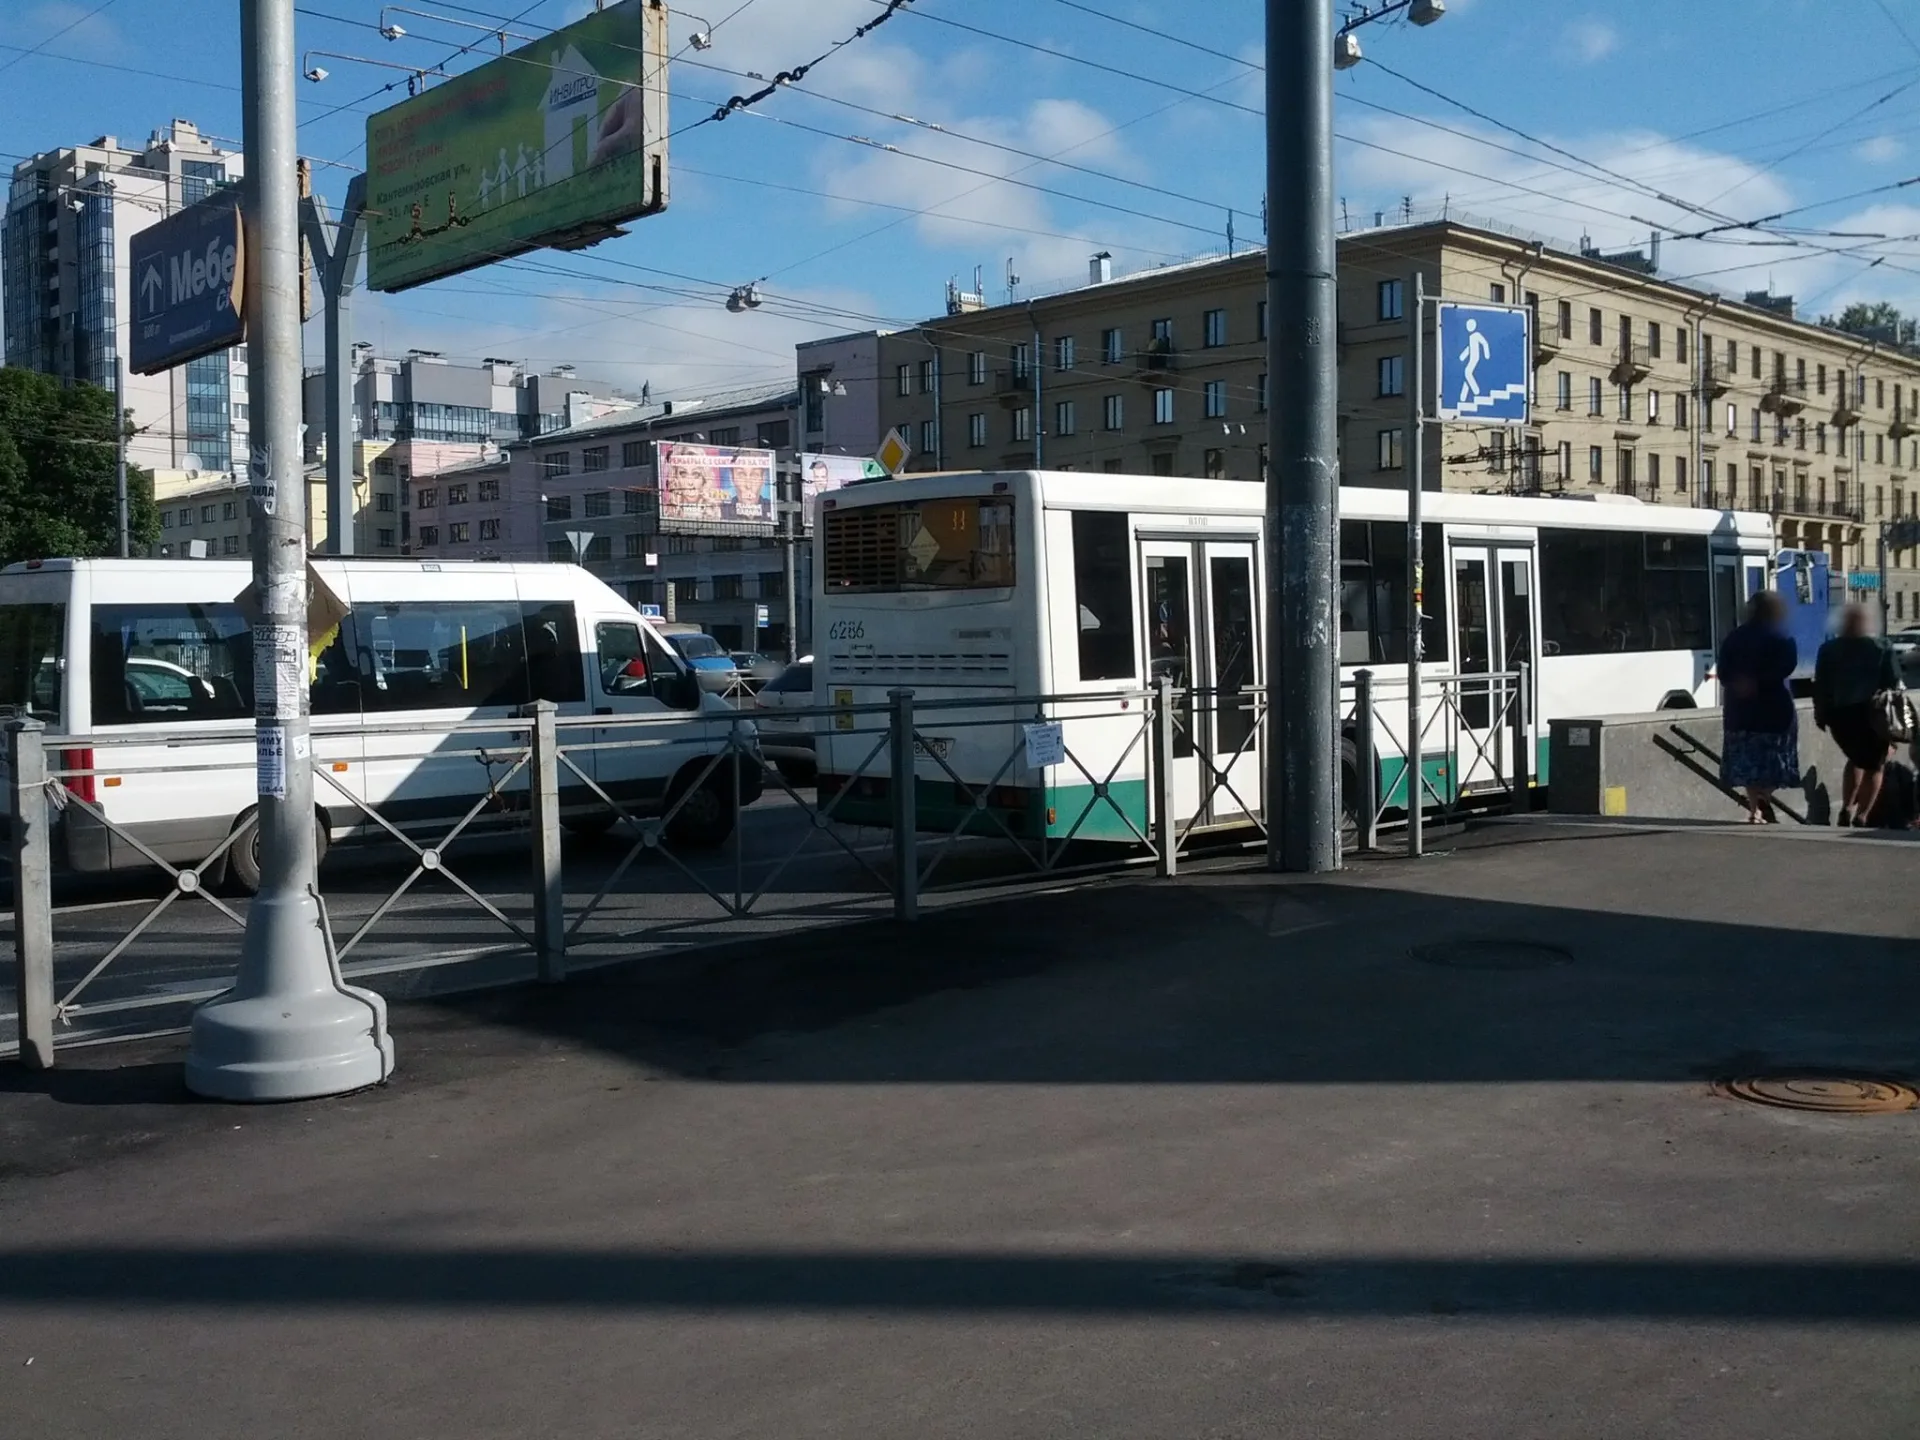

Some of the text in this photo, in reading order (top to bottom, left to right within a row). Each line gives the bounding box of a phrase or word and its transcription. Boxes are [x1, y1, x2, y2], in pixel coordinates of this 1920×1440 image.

[549, 74, 596, 105] ИНВИТРО
[170, 235, 236, 305] Мебе
[829, 620, 865, 640] 6286
